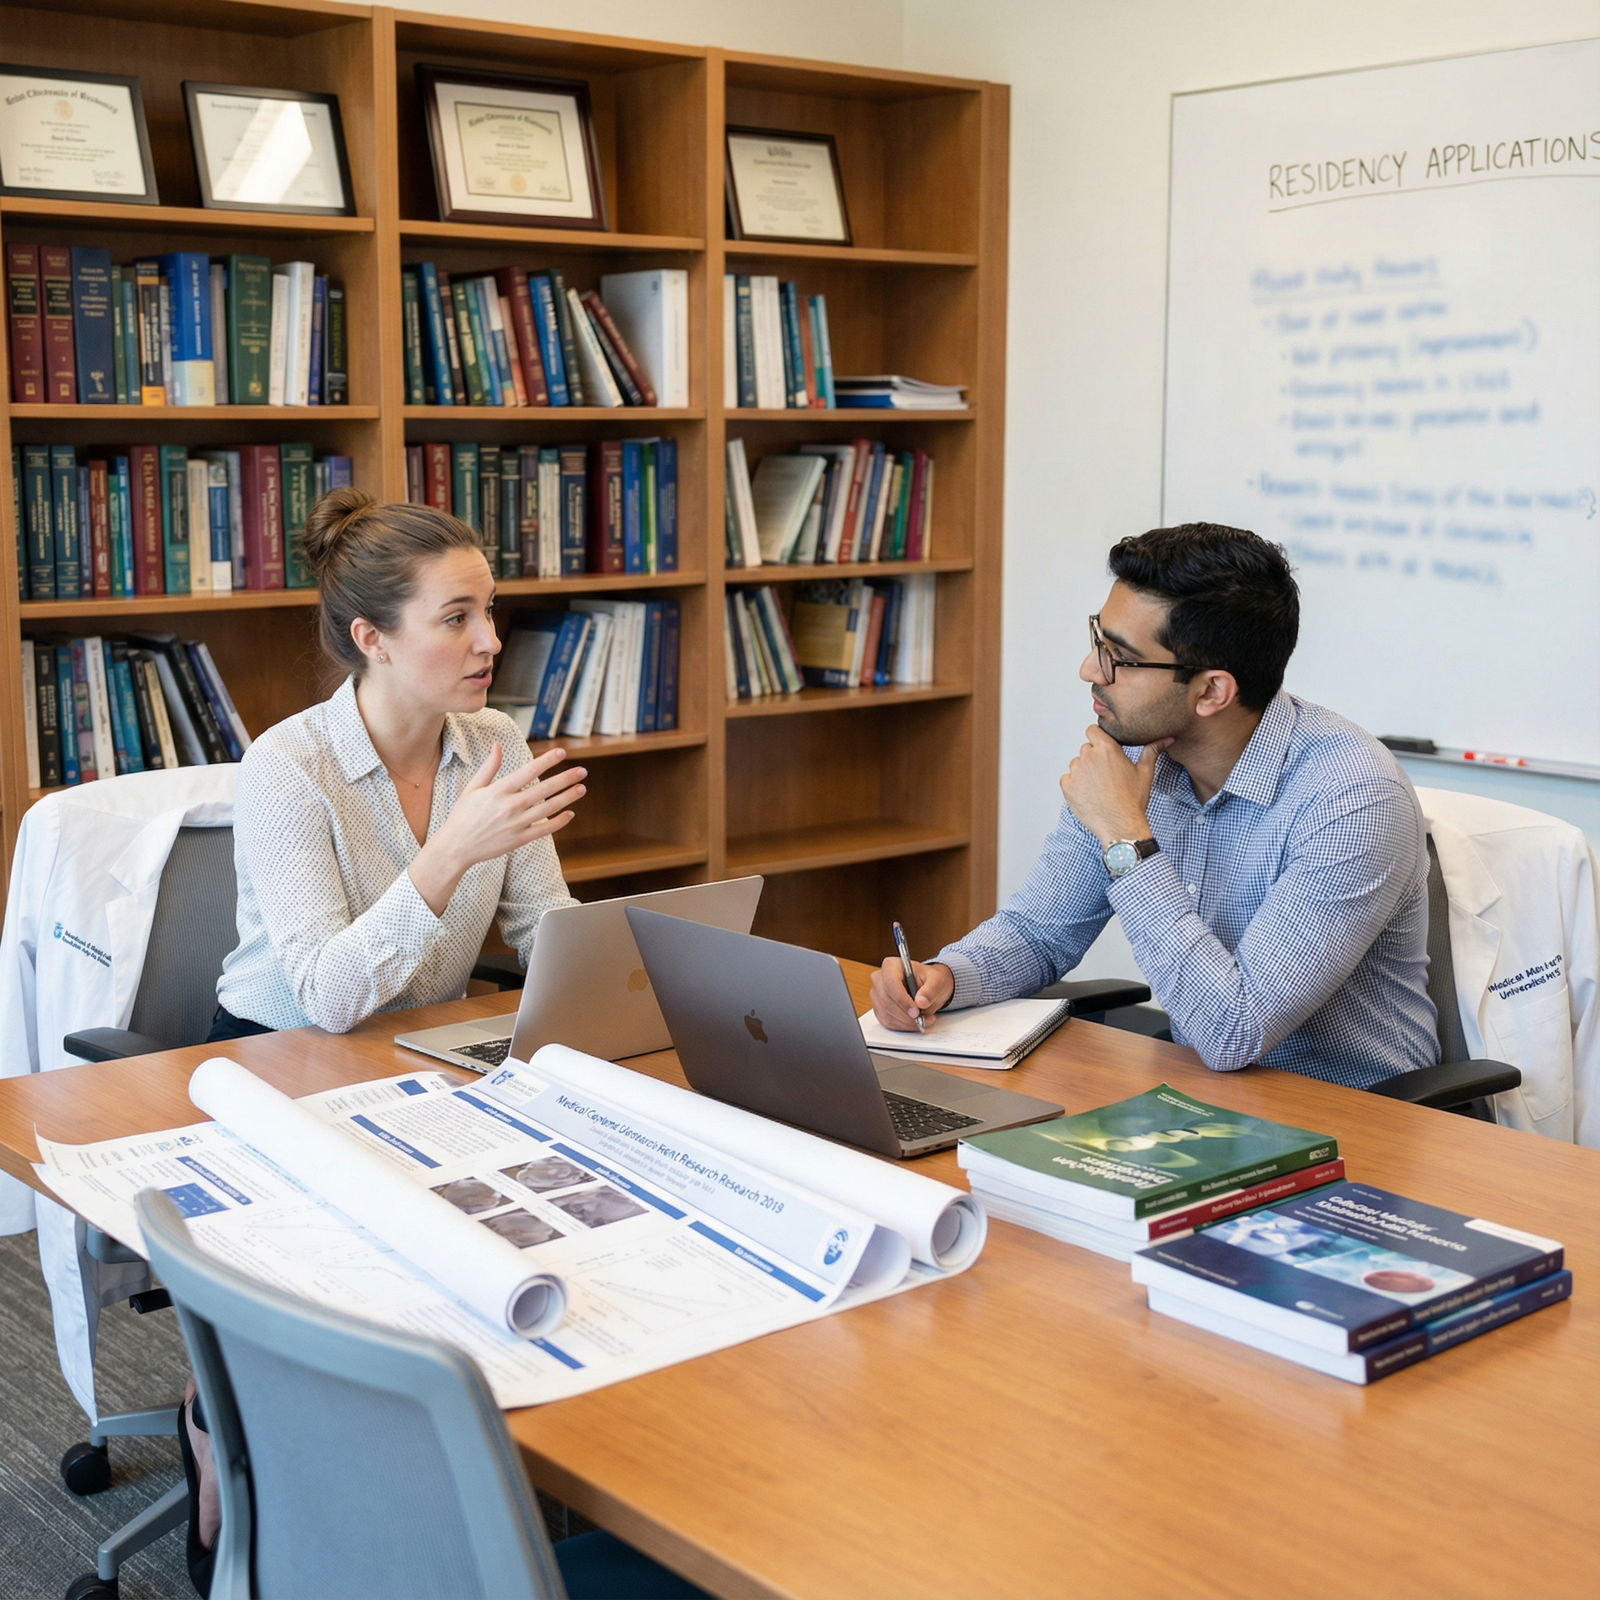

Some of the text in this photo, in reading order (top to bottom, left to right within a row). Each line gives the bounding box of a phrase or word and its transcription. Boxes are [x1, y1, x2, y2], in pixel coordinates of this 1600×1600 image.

[1269, 130, 1600, 199] RESIDENCY APPLICATIONS
[718, 1173, 760, 1203] Research
